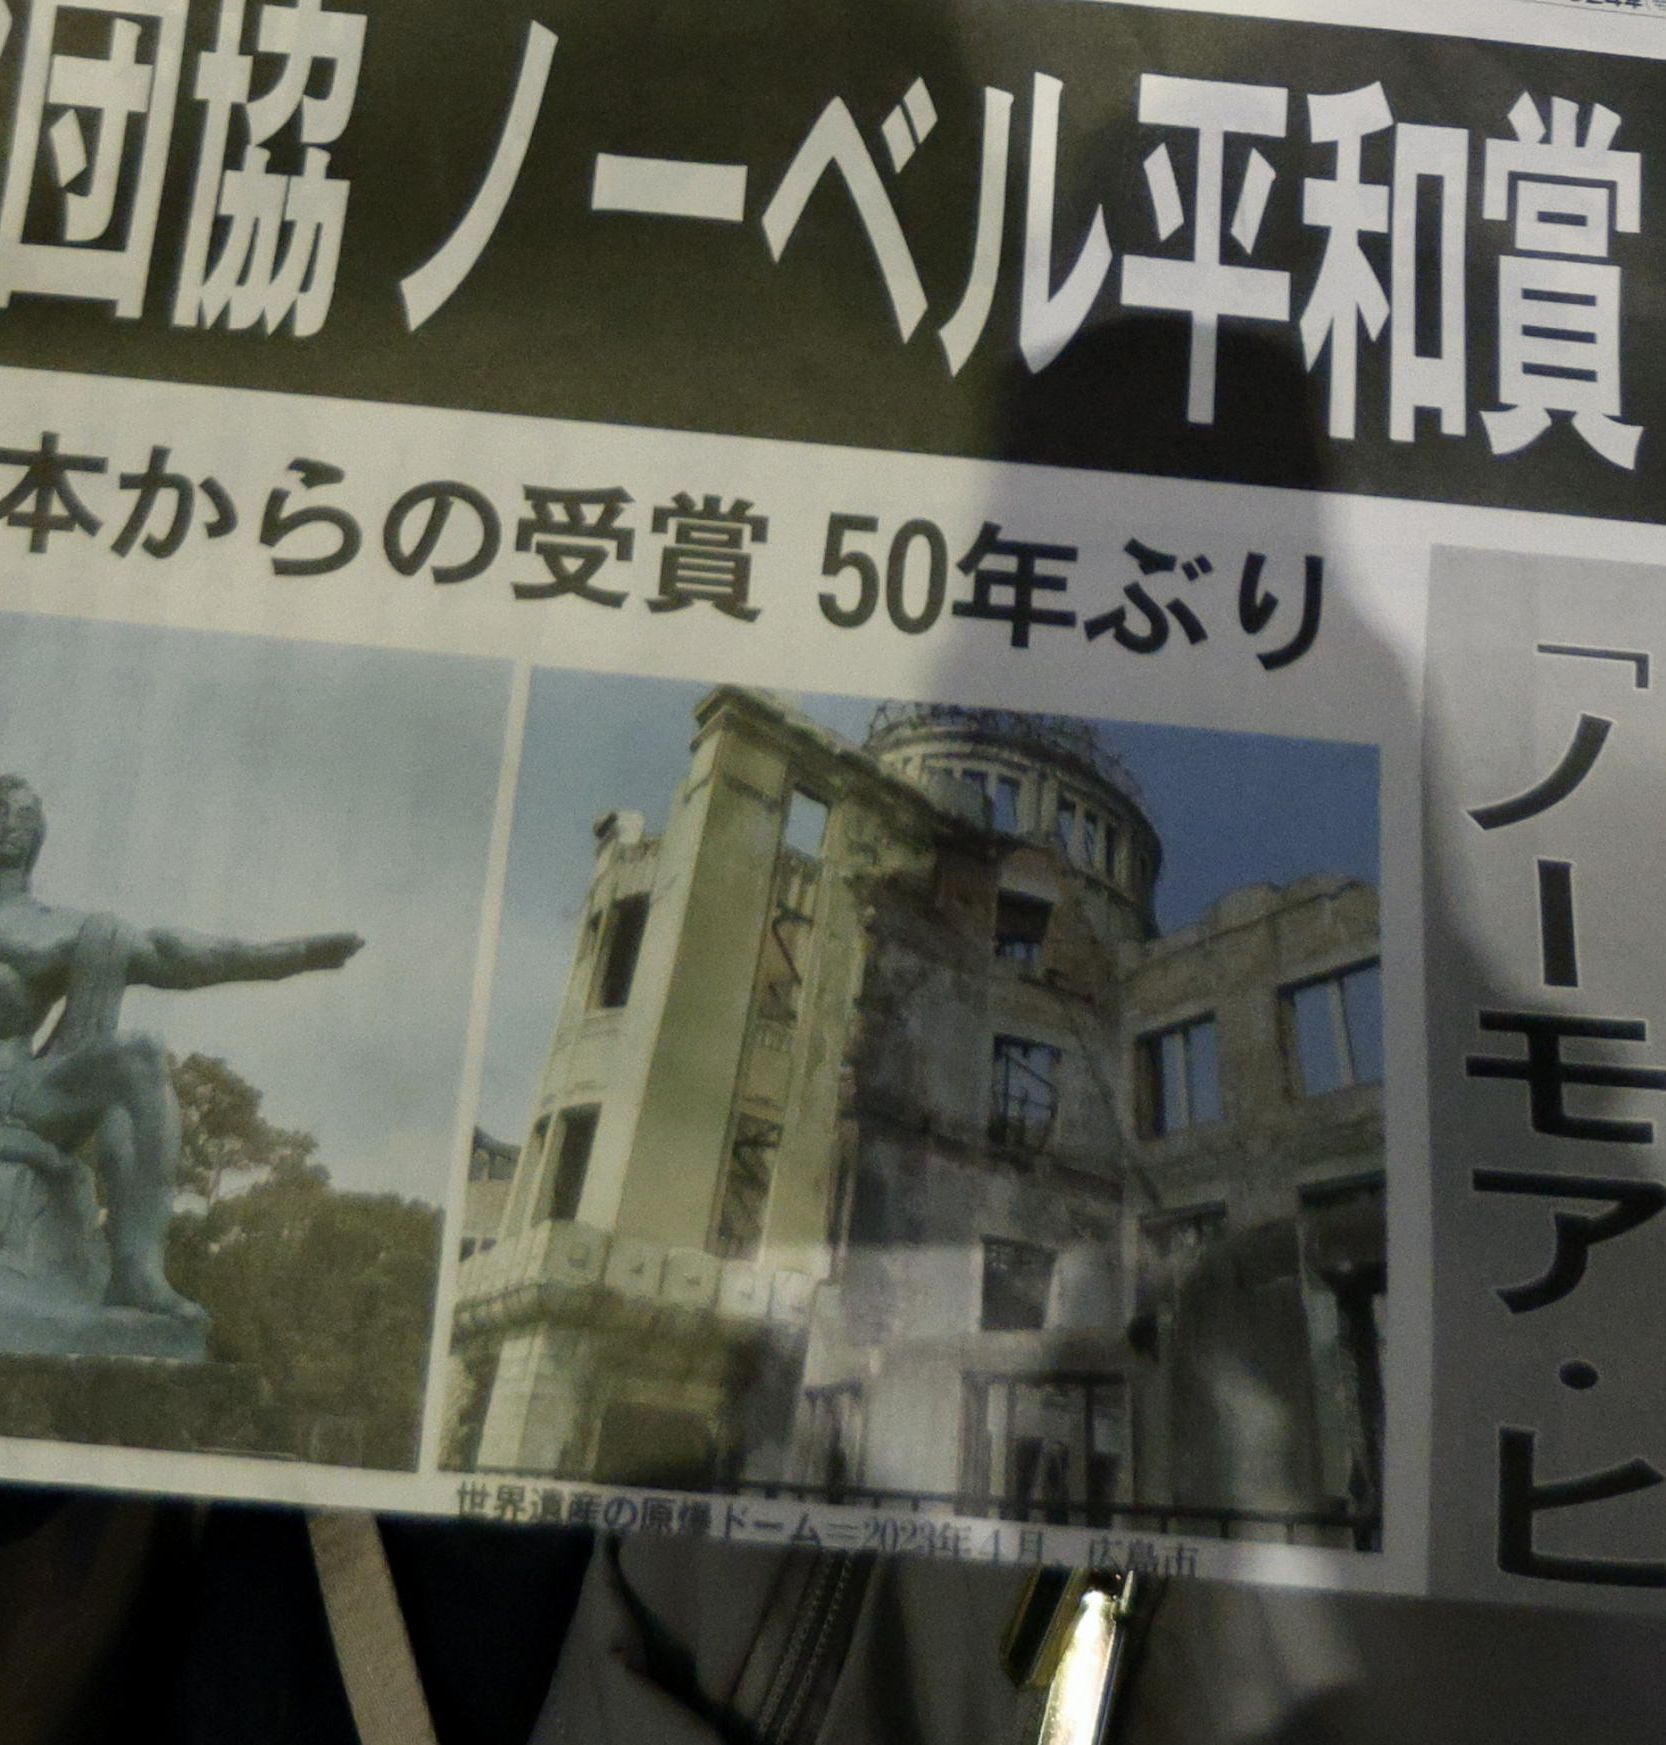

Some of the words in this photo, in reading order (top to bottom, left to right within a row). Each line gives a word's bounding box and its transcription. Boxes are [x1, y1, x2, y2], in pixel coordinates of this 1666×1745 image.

[399, 20, 1644, 471] ノーベル平和賞
[817, 516, 1328, 672] 50年ぶり
